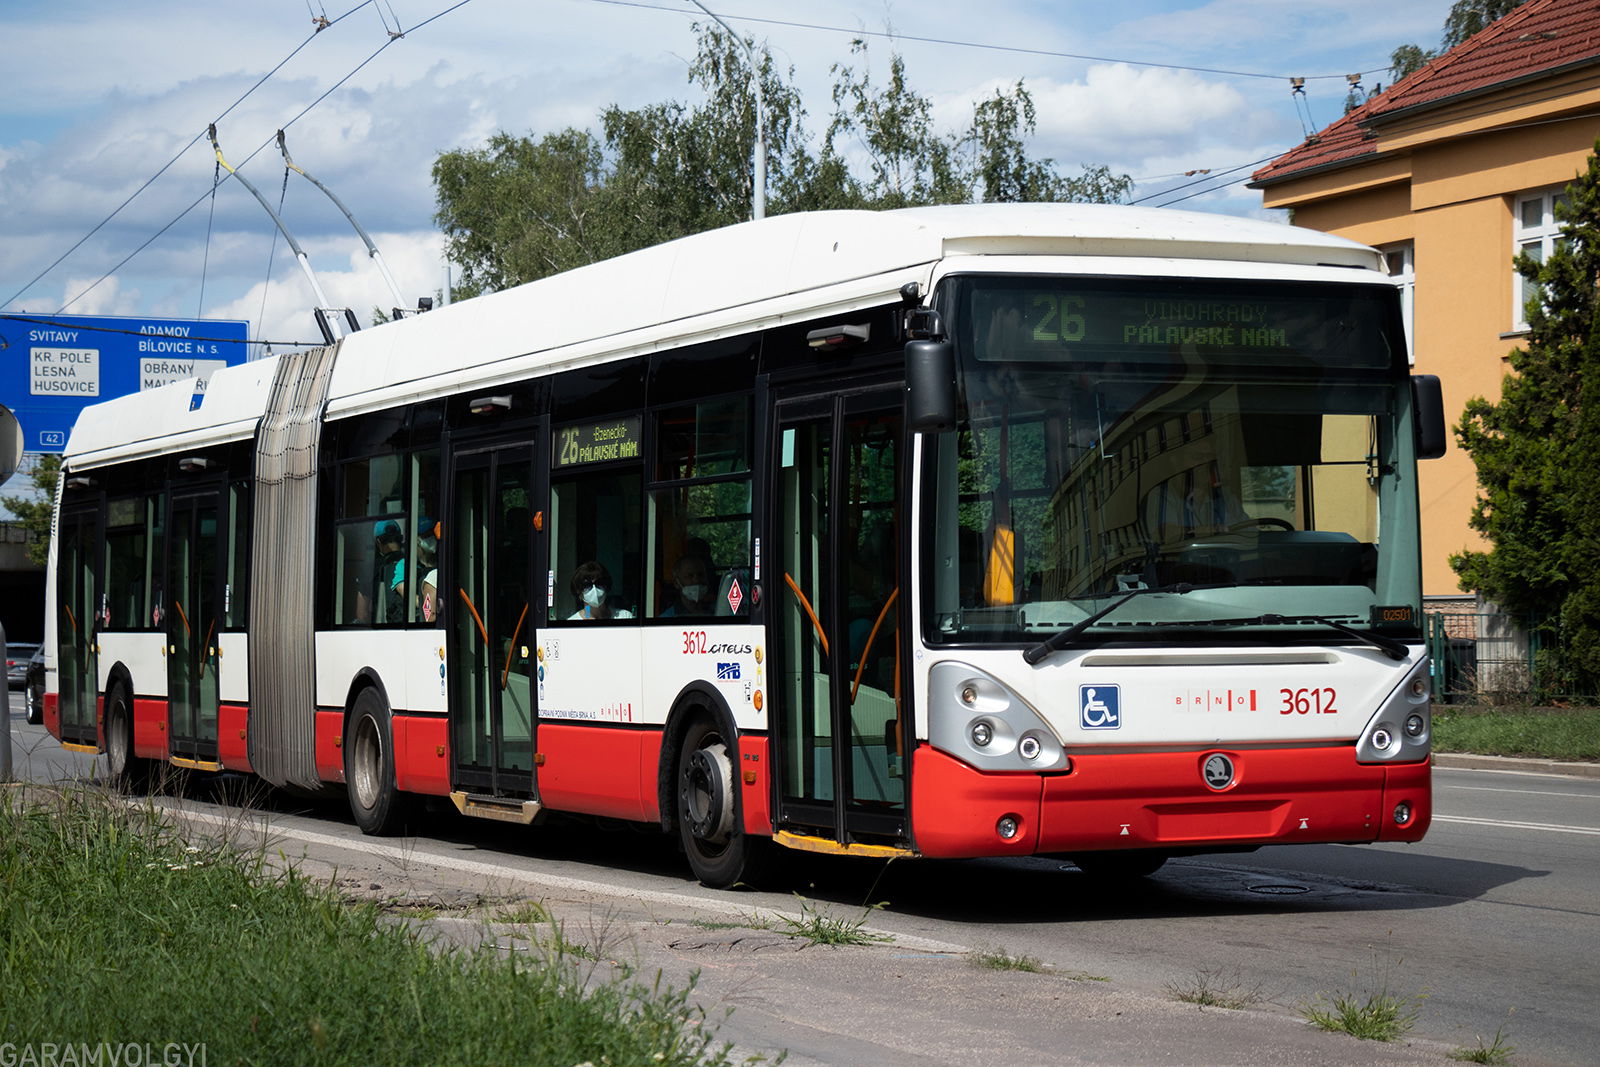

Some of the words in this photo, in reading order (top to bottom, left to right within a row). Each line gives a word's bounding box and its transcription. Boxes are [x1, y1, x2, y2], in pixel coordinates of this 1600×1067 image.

[1144, 300, 1268, 322] VINOHRADY
[1032, 294, 1087, 343] 26
[29, 330, 79, 343] SVITAVY
[140, 325, 190, 337] ADAMOV
[139, 339, 192, 353] BÍLOVICE
[197, 345, 206, 354] N.
[210, 345, 219, 354] S.
[34, 352, 54, 363] KR.
[60, 352, 92, 364] POLE
[34, 364, 76, 377] LESNÁ
[144, 362, 194, 375] OBŘANY
[34, 380, 95, 393] HUSOVICE
[46, 433, 59, 444] 42
[561, 426, 580, 465] 26
[682, 631, 707, 654] 3612
[1279, 687, 1338, 715] 3612
